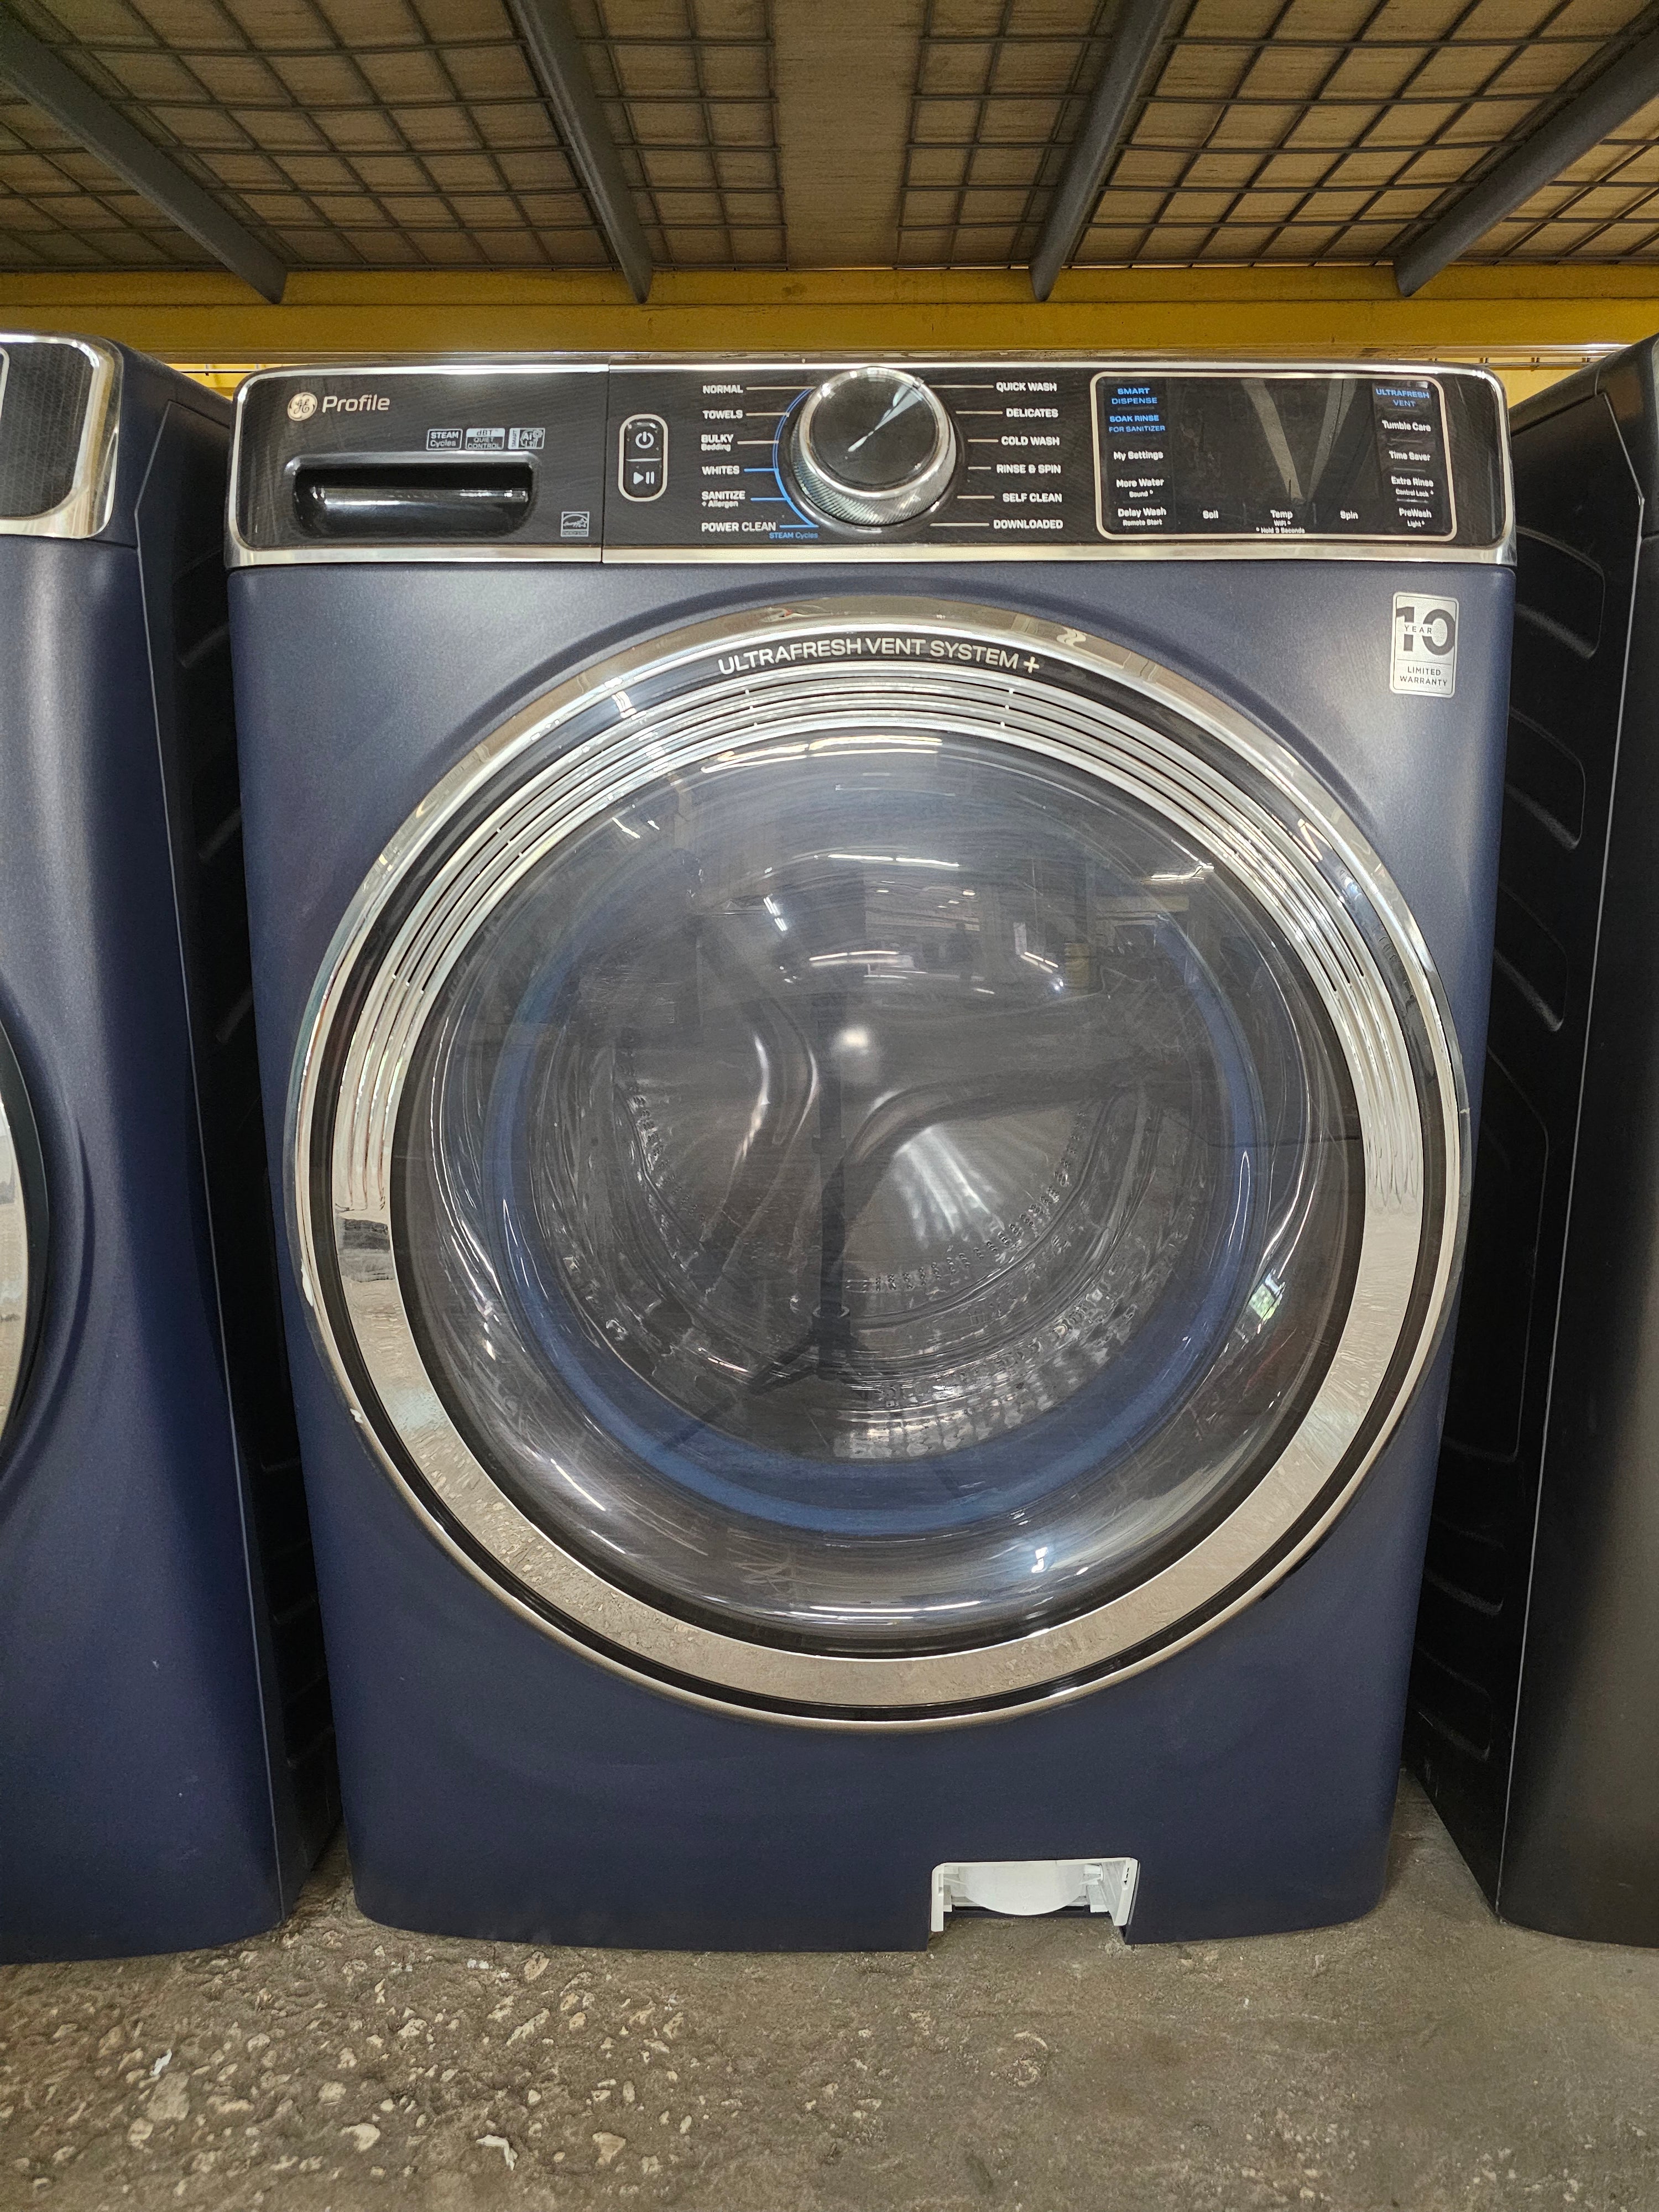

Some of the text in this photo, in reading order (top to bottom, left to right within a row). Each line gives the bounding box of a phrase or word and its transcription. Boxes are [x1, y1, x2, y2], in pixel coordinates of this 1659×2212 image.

[702, 385, 743, 394] NORMAL
[996, 382, 1057, 392] QUICK WASH
[1375, 388, 1430, 398] ULTRAFRESH
[322, 394, 390, 413] Profile
[702, 410, 743, 419] TOWELS
[1006, 408, 1058, 418] DELICATES
[1382, 420, 1431, 431] Tumble Care
[701, 434, 733, 443] BULKY
[1001, 436, 1060, 446] COLD WASH
[1113, 450, 1164, 461] My Settings
[1389, 450, 1431, 461] Time Saver
[702, 466, 739, 474] WHITES
[997, 465, 1061, 474] RINSE & SPIN
[1116, 478, 1164, 488] More Water
[1391, 476, 1434, 487] Extra Rinse
[702, 491, 745, 500] SANITIZE
[1395, 488, 1415, 496] Control
[1003, 493, 1062, 502] SELF CLEAN
[1118, 507, 1167, 518] Delay Wash
[1203, 510, 1219, 519] Soil
[1270, 509, 1293, 519] Temp
[1340, 510, 1358, 520] Spin
[1399, 507, 1432, 518] PreWash
[702, 522, 776, 532] POWER CLEAN
[994, 520, 1063, 529] DOWNLOADED
[1407, 520, 1422, 528] Light
[795, 532, 818, 540] Cycles
[1396, 606, 1455, 656] 10
[1404, 625, 1432, 634] YEAR
[718, 637, 862, 675] ULTRAFRESH
[865, 638, 926, 655] VENT
[929, 640, 1019, 669] SYSTEM
[1407, 666, 1441, 676] LIMITED
[1400, 675, 1448, 686] WARRANTY
